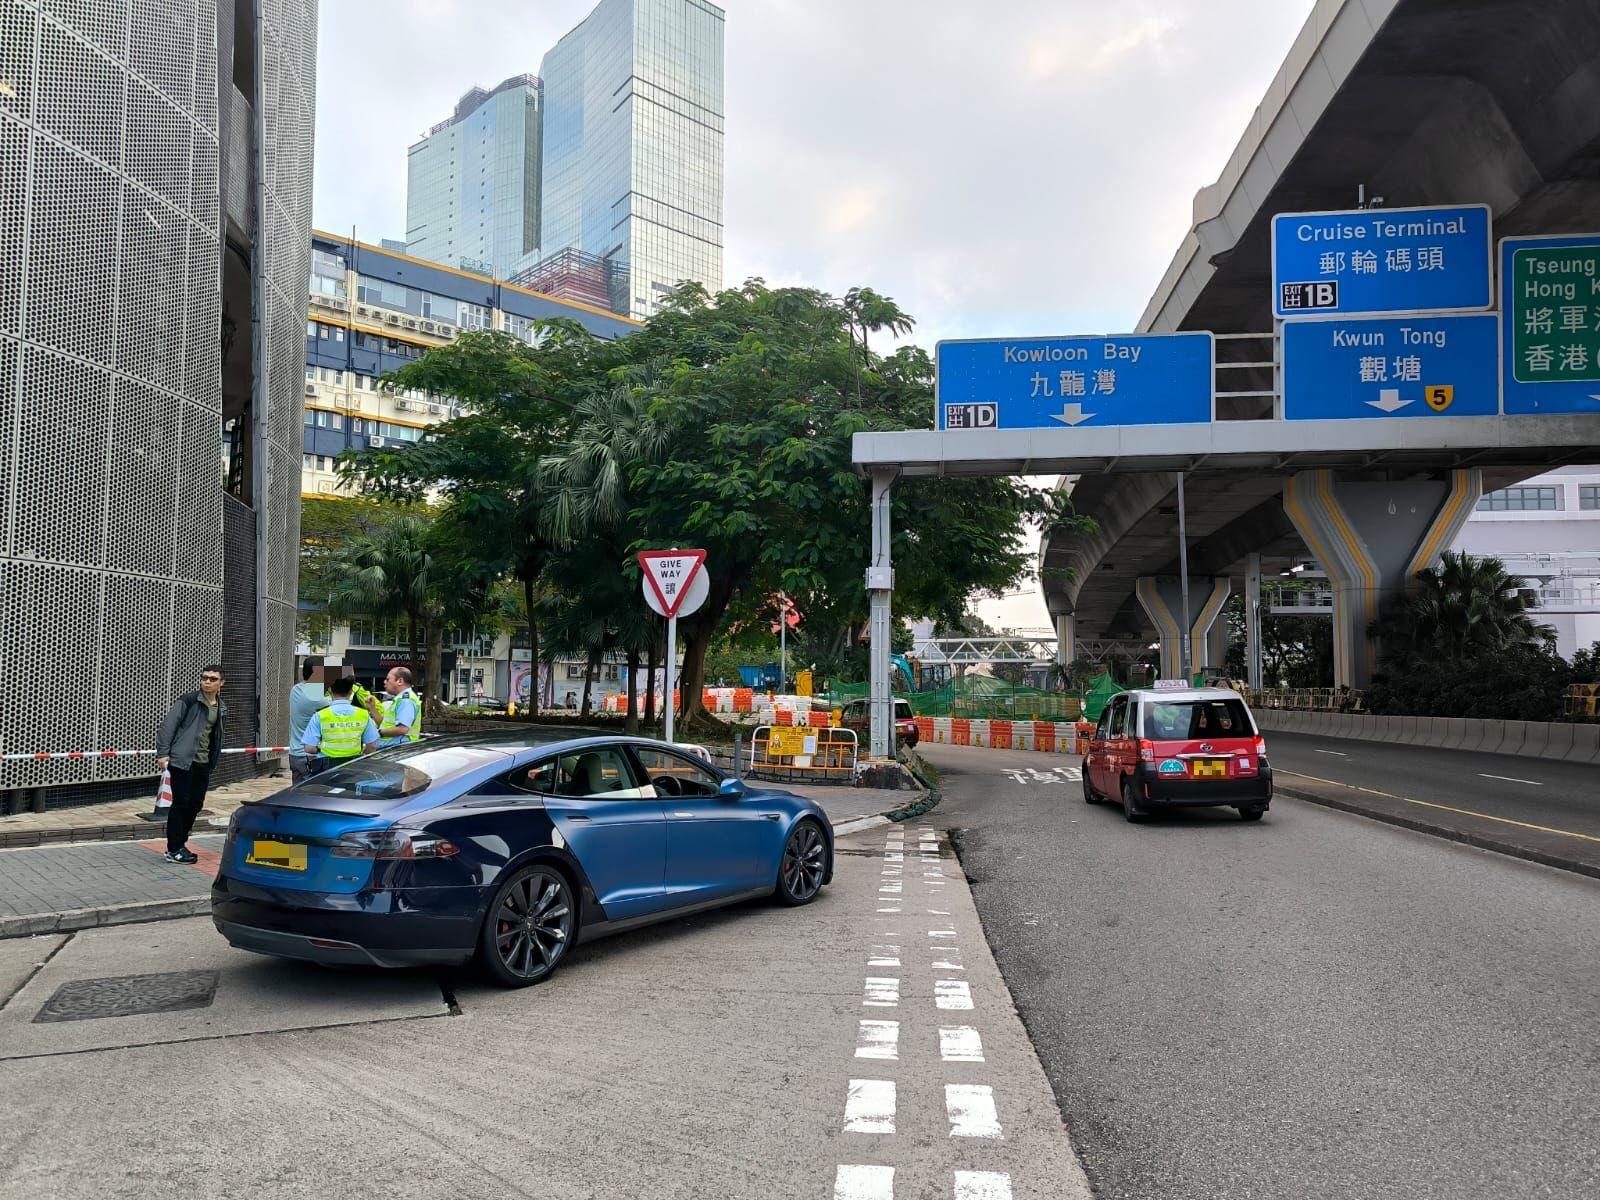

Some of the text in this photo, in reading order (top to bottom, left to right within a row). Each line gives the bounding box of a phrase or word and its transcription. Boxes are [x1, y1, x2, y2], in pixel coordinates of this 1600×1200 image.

[1297, 217, 1466, 241] Cruise Terminal
[1319, 246, 1445, 275] 郵輪碼頭
[1525, 258, 1595, 276] Tseung
[1284, 285, 1301, 295] EXIT
[1305, 284, 1334, 307] 1B
[1525, 281, 1575, 300] Hong
[1284, 295, 1301, 307] 出
[1333, 328, 1446, 347] Kwun Tong
[1004, 343, 1141, 362] Kowloon Bay
[1359, 355, 1422, 382] 觀塘
[1030, 368, 1116, 397] 九龍灣
[1433, 390, 1447, 405] 5
[948, 406, 964, 415] EXIT
[967, 406, 995, 426] 1D
[948, 416, 963, 427] 出
[660, 560, 681, 568] GIVE
[661, 570, 681, 578] WAY
